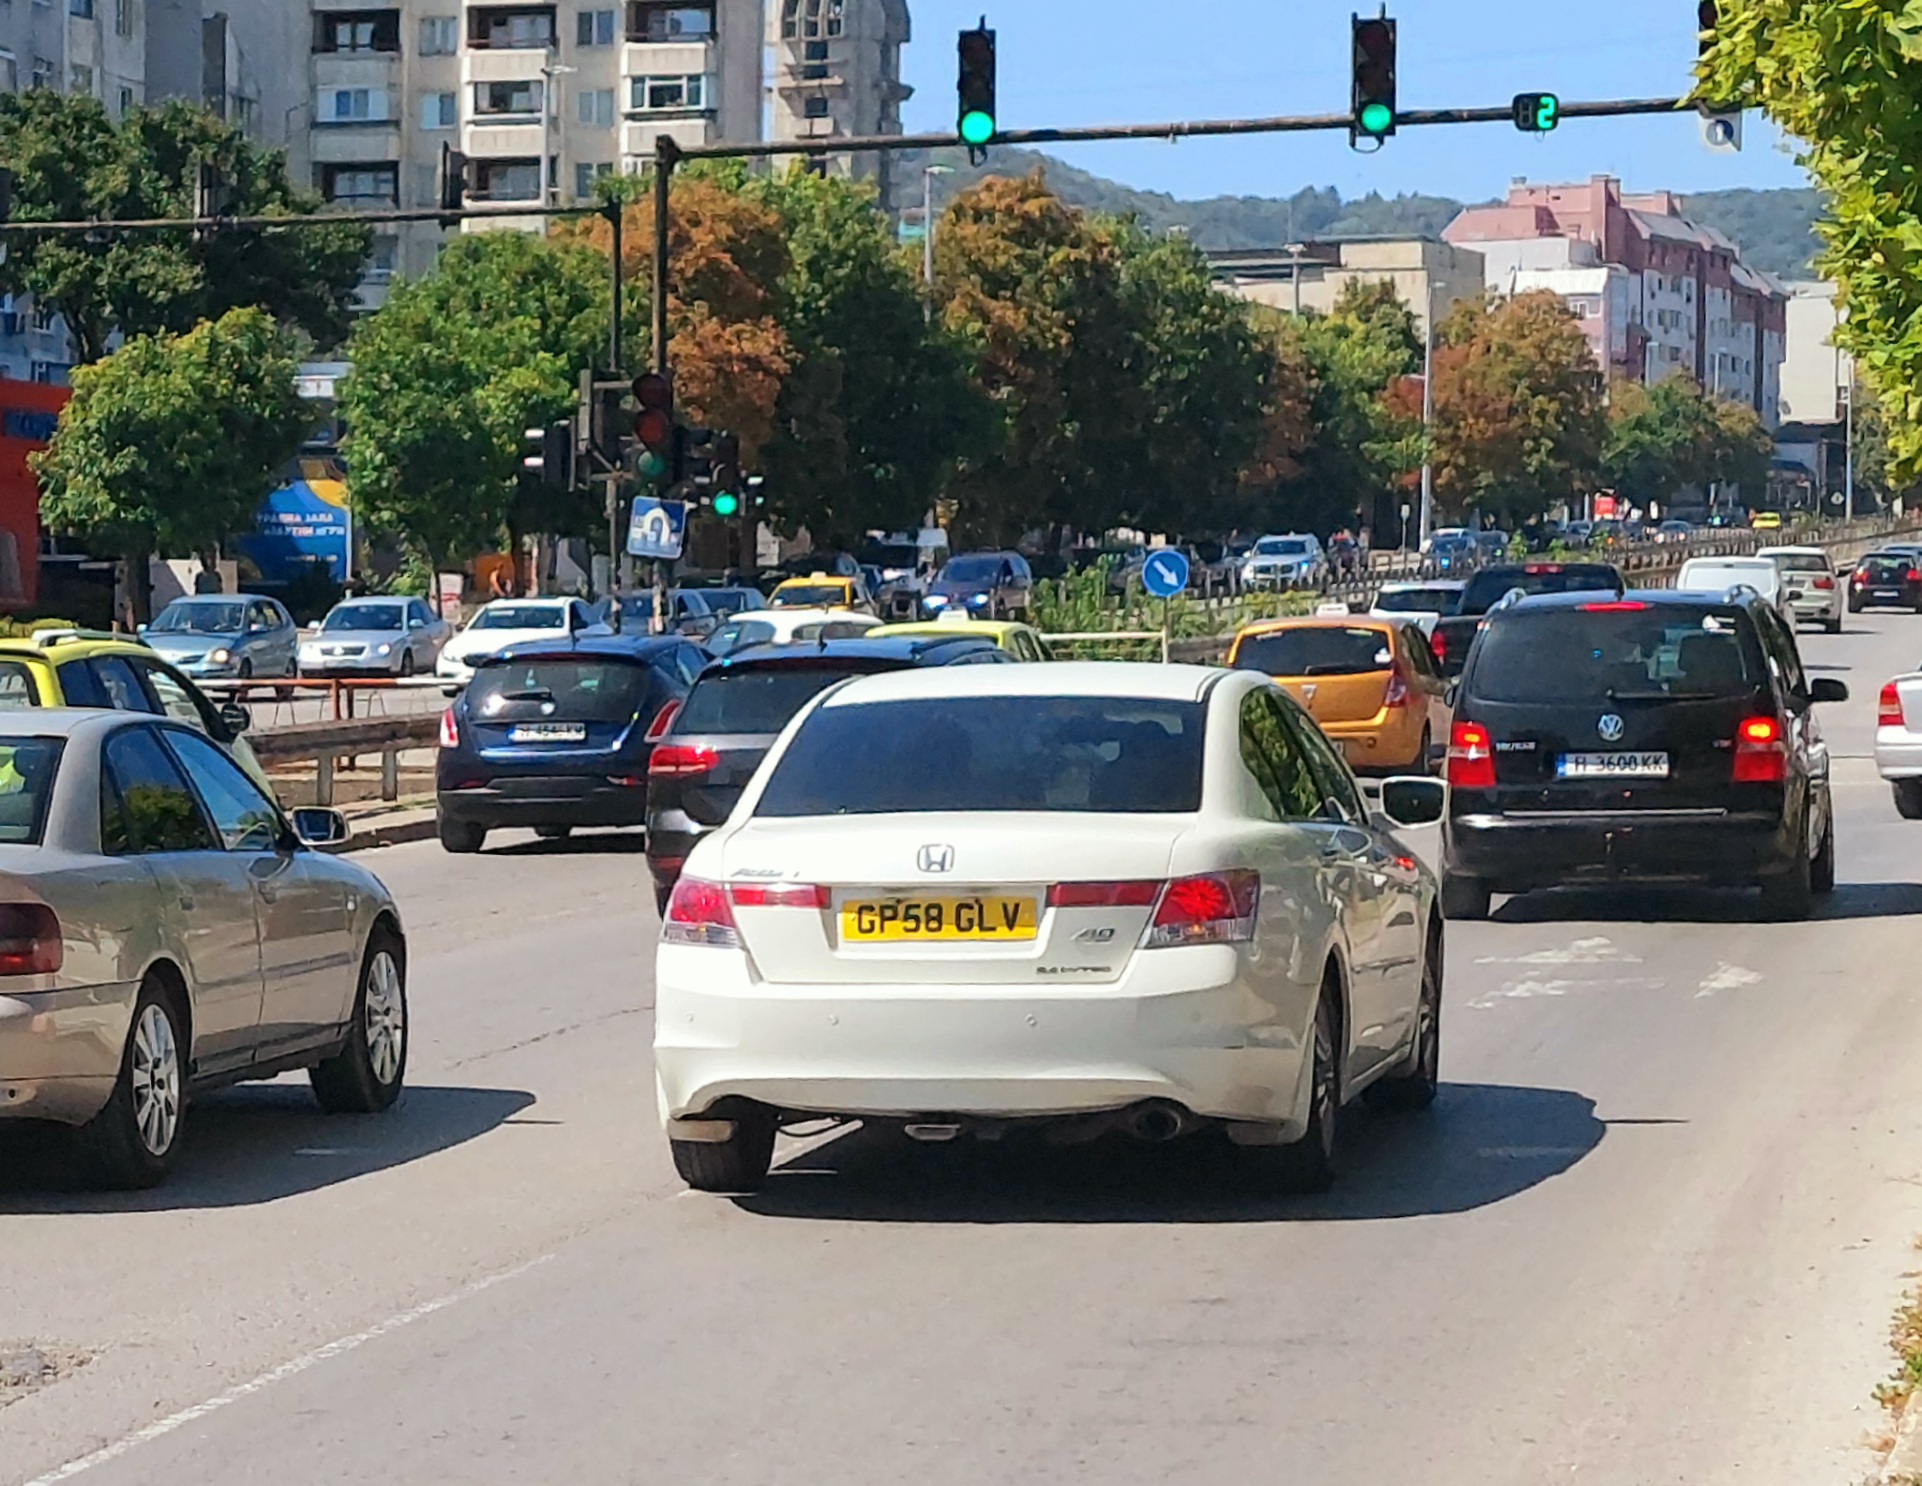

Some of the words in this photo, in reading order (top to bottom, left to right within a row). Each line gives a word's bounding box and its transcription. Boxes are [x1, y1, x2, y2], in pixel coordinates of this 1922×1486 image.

[1537, 96, 1555, 128] 2
[857, 904, 943, 934] GP58
[955, 902, 1020, 932] GLV
